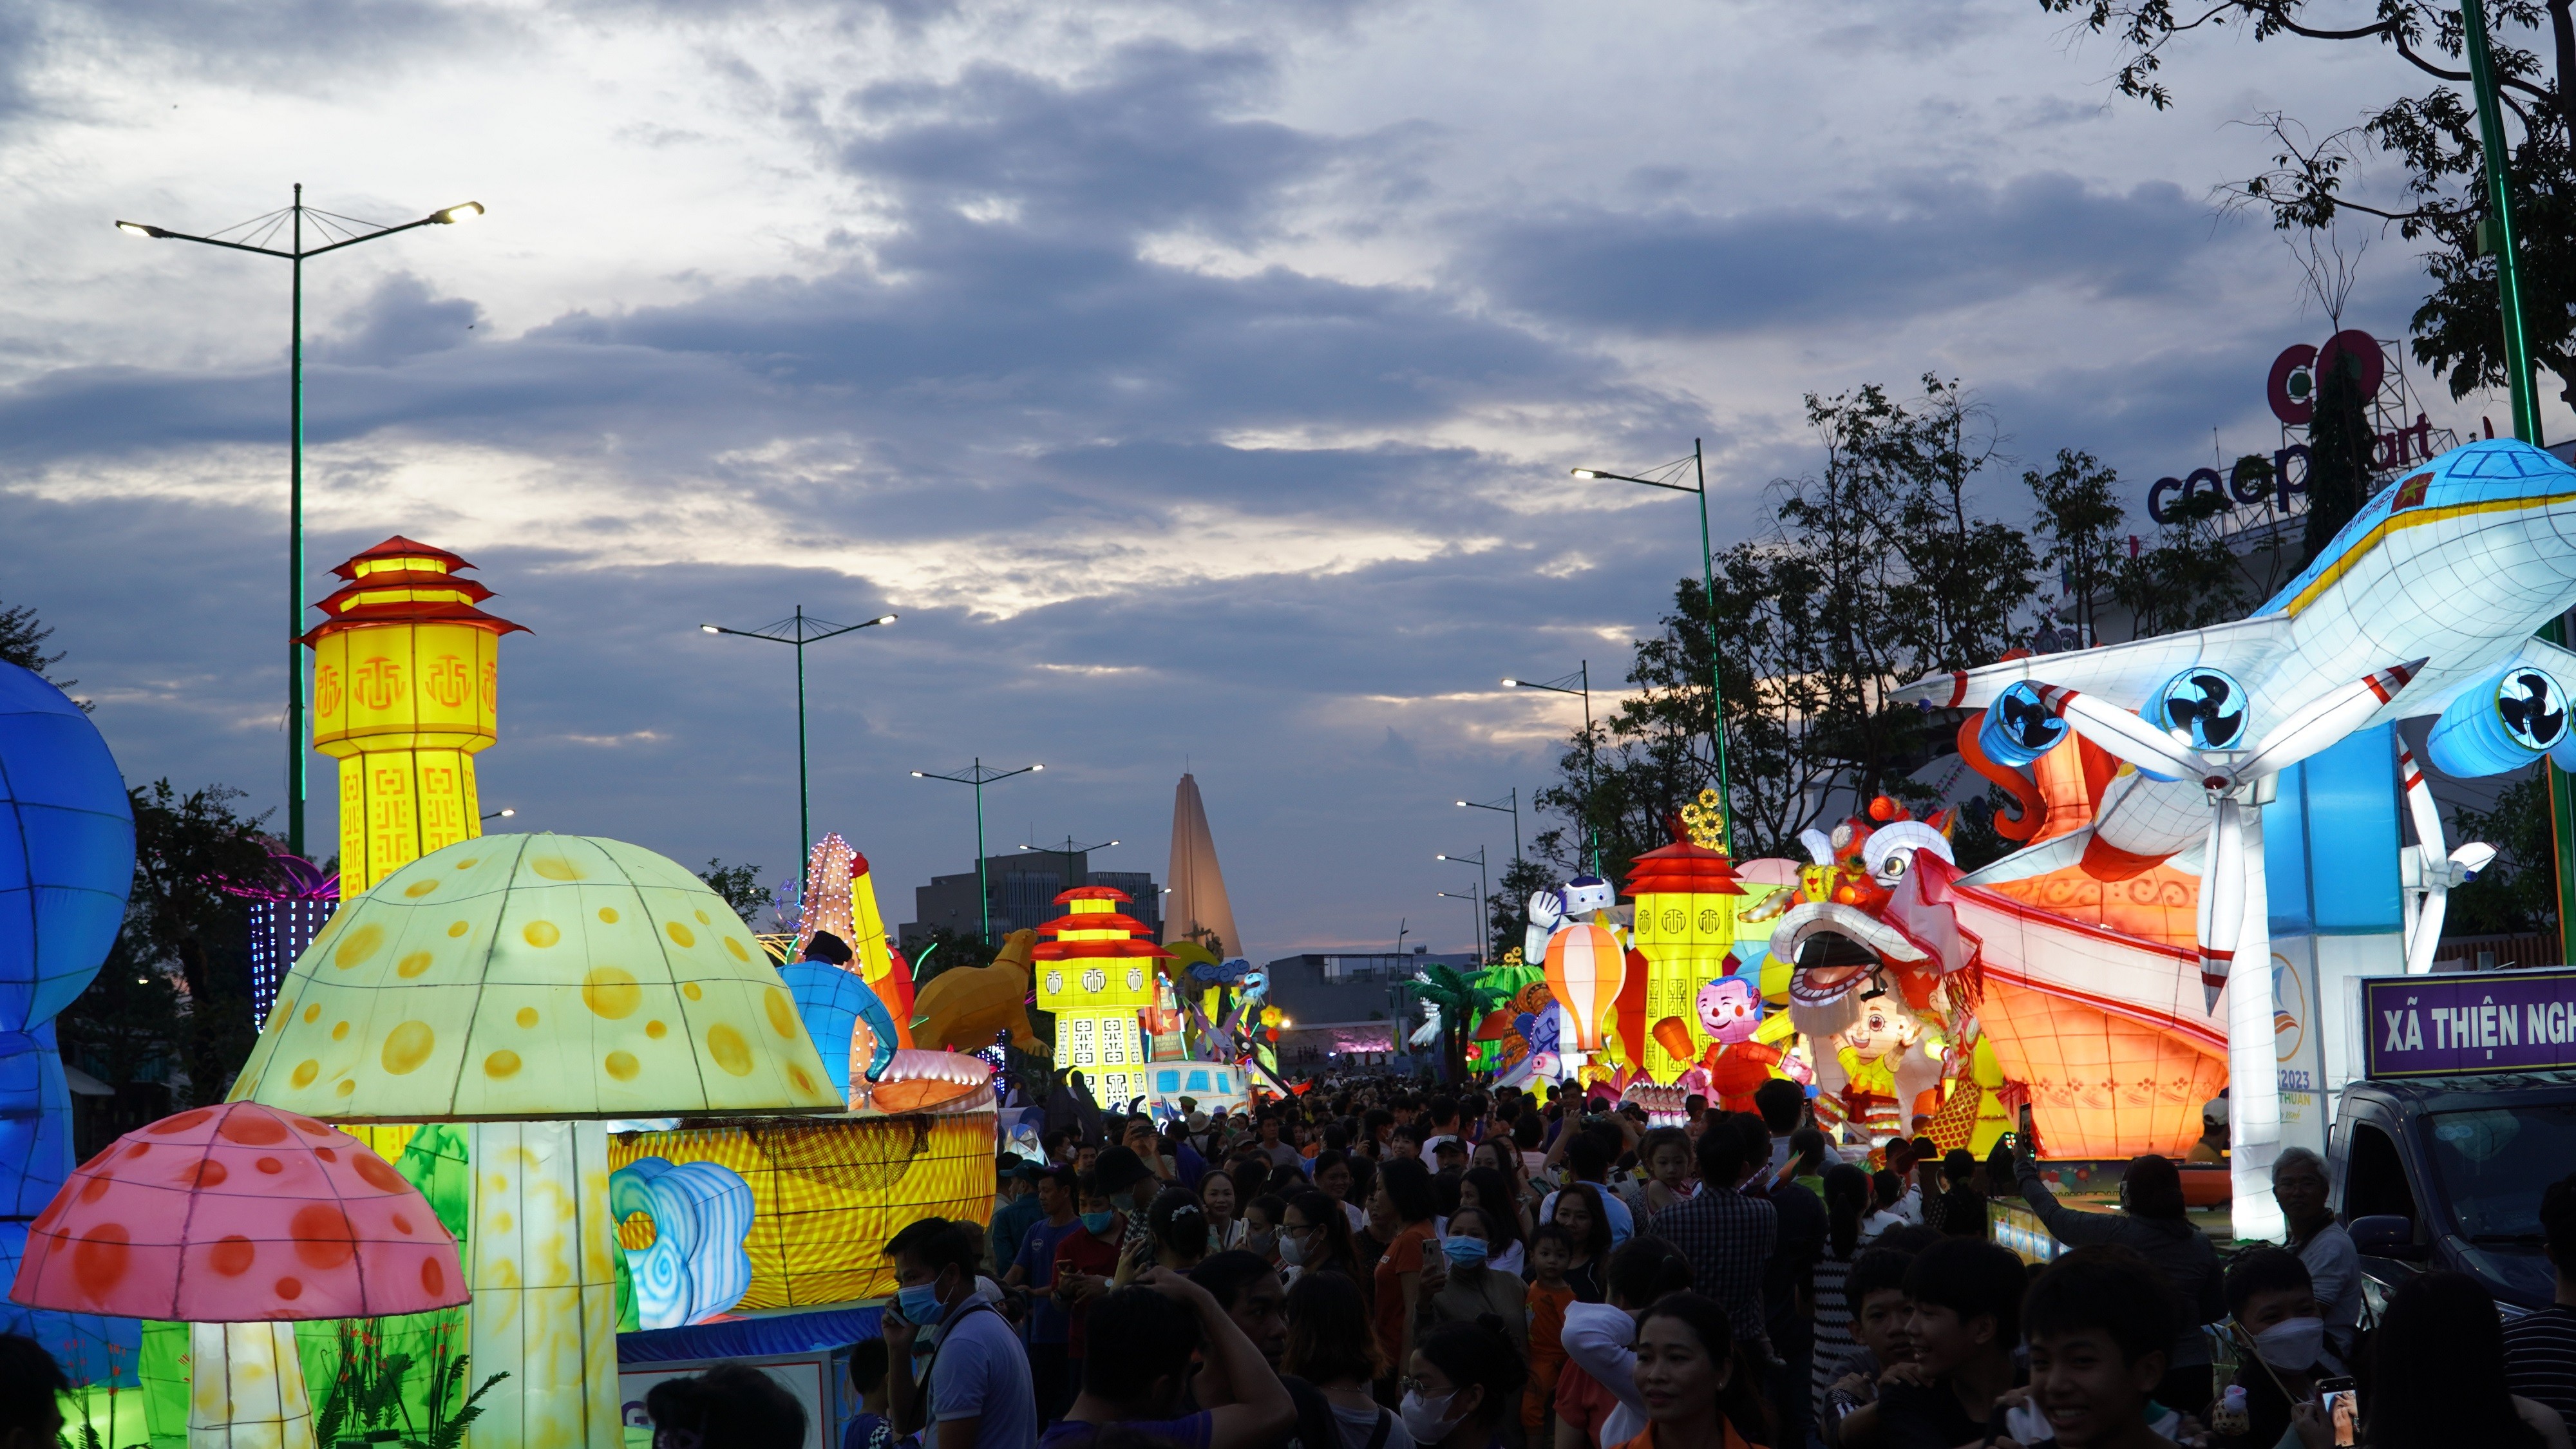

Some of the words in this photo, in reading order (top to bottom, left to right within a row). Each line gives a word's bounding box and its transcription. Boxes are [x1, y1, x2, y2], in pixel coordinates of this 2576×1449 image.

[2383, 996, 2424, 1052] XÃ
[2431, 995, 2519, 1060] THIỆN
[2280, 1069, 2310, 1090] 2023
[2278, 1090, 2311, 1108] THUẬN
